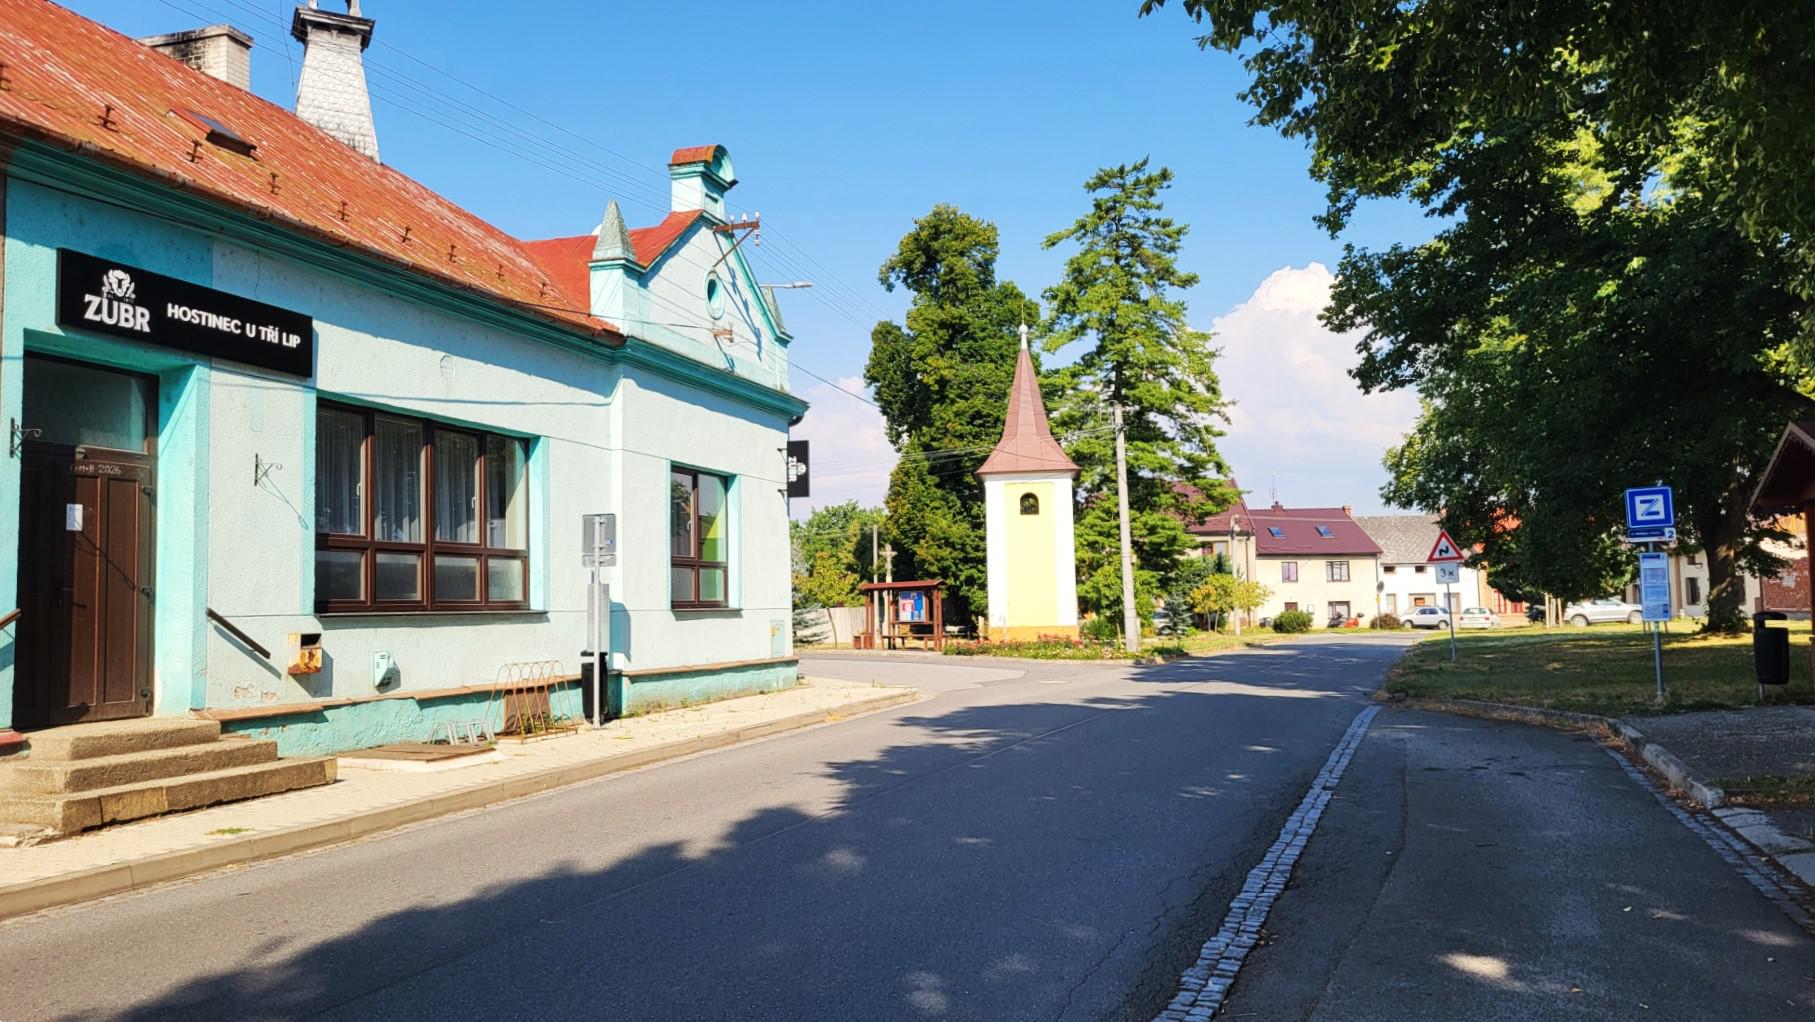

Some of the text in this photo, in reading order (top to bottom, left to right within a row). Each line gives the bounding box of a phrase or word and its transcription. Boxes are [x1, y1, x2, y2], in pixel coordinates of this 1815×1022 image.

[84, 293, 151, 333] ZUBR
[167, 302, 301, 349] HOSTINEC U TŘÍ LIP
[98, 464, 121, 475] 2026
[788, 456, 797, 482] ZUBR
[1667, 530, 1675, 539] 2
